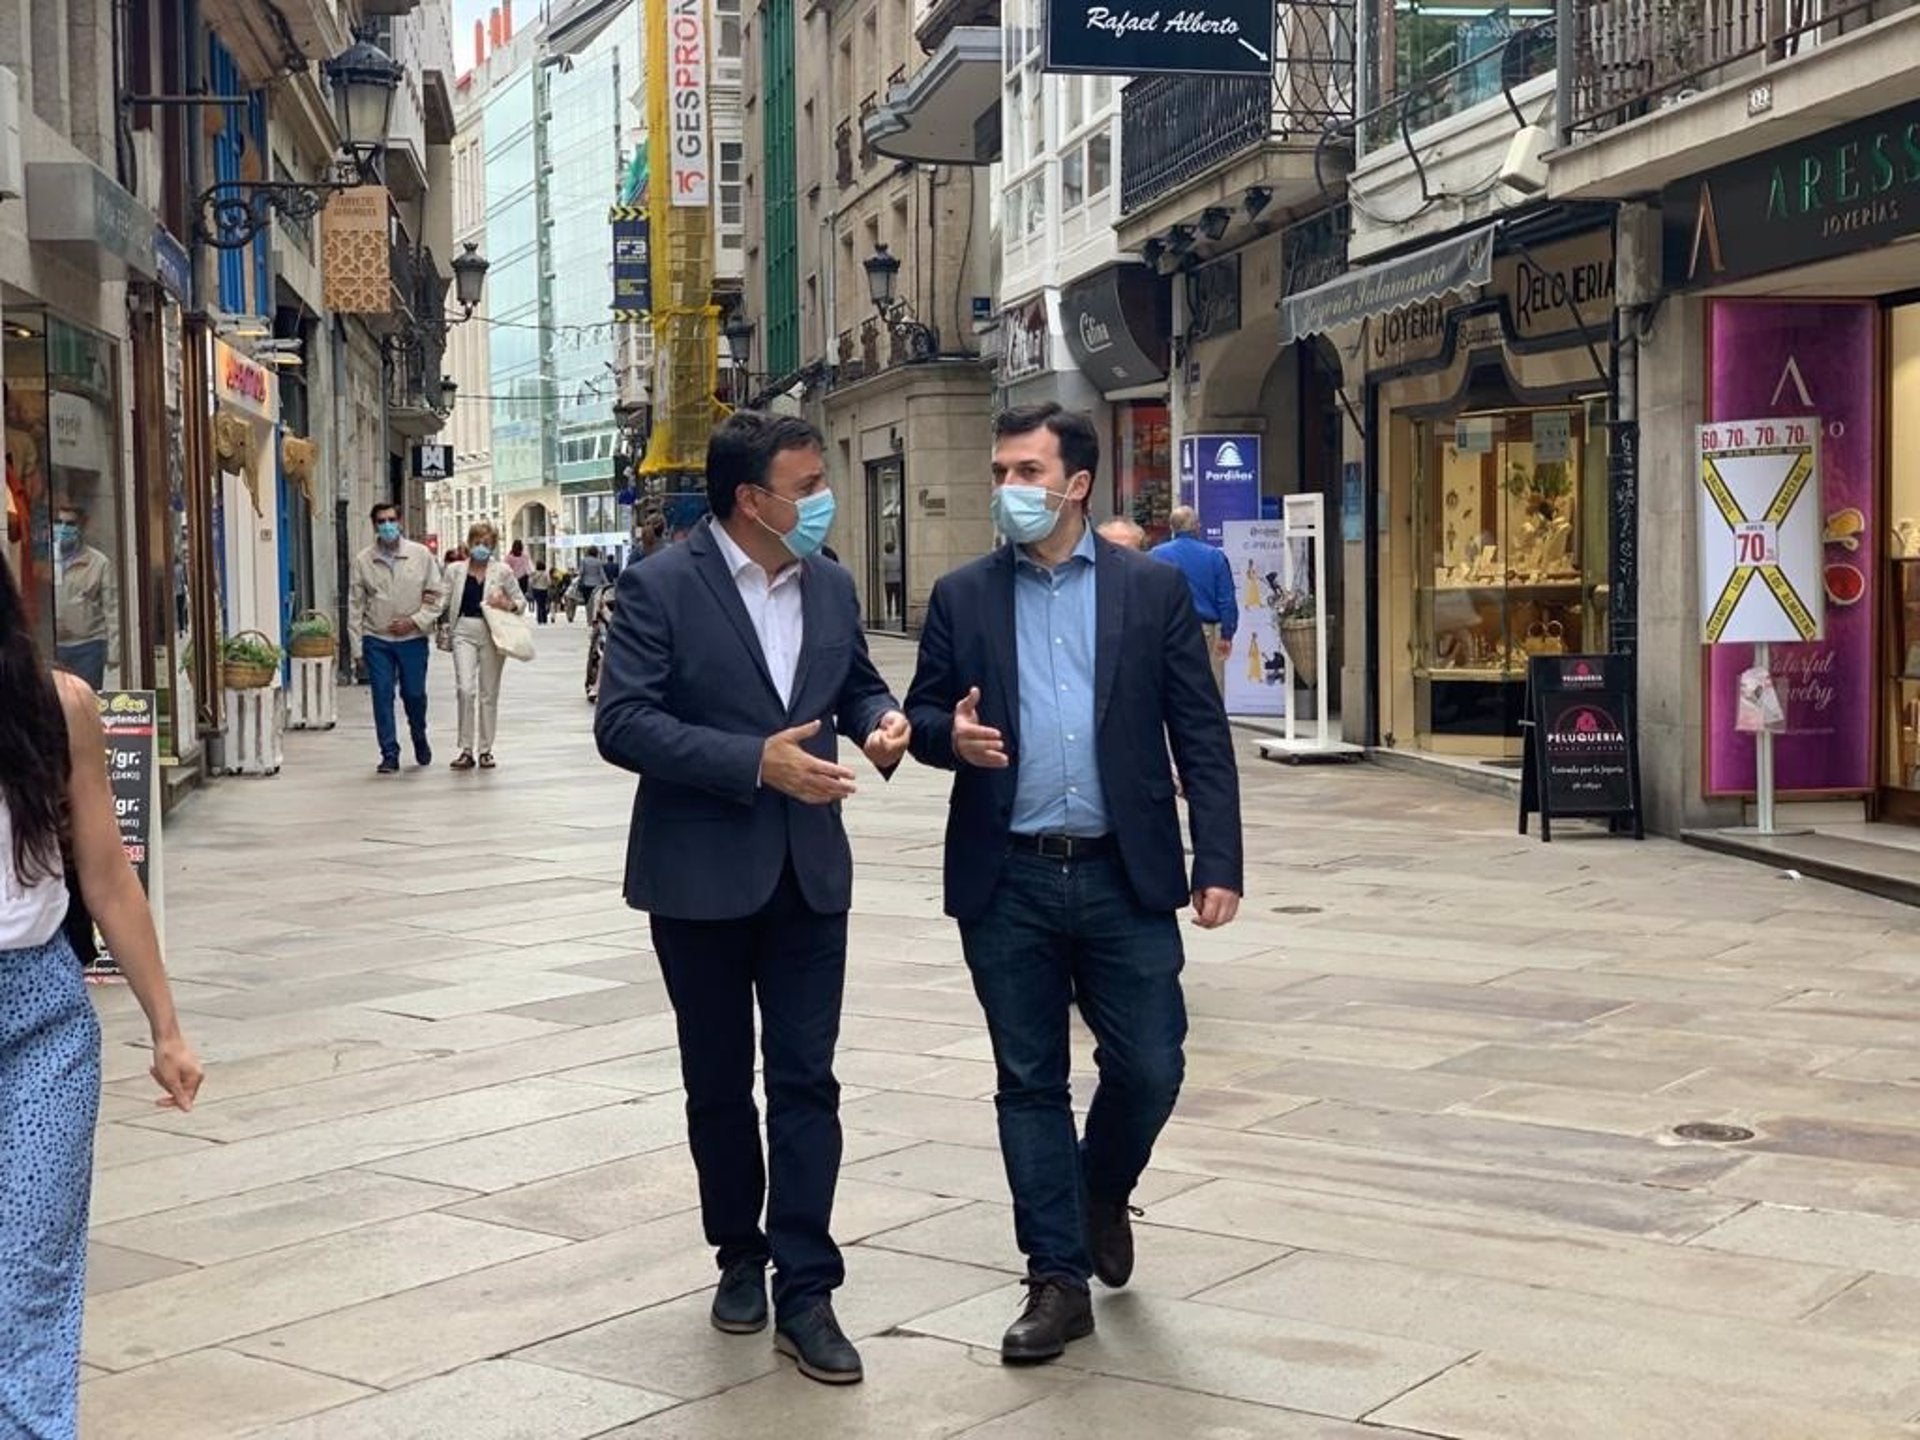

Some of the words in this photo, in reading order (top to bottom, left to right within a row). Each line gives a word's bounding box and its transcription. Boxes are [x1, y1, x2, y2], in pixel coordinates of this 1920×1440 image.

[1086, 6, 1160, 38] Rafael
[1163, 11, 1240, 34] Alberto
[1546, 732, 1625, 743] PELUQUERIA
